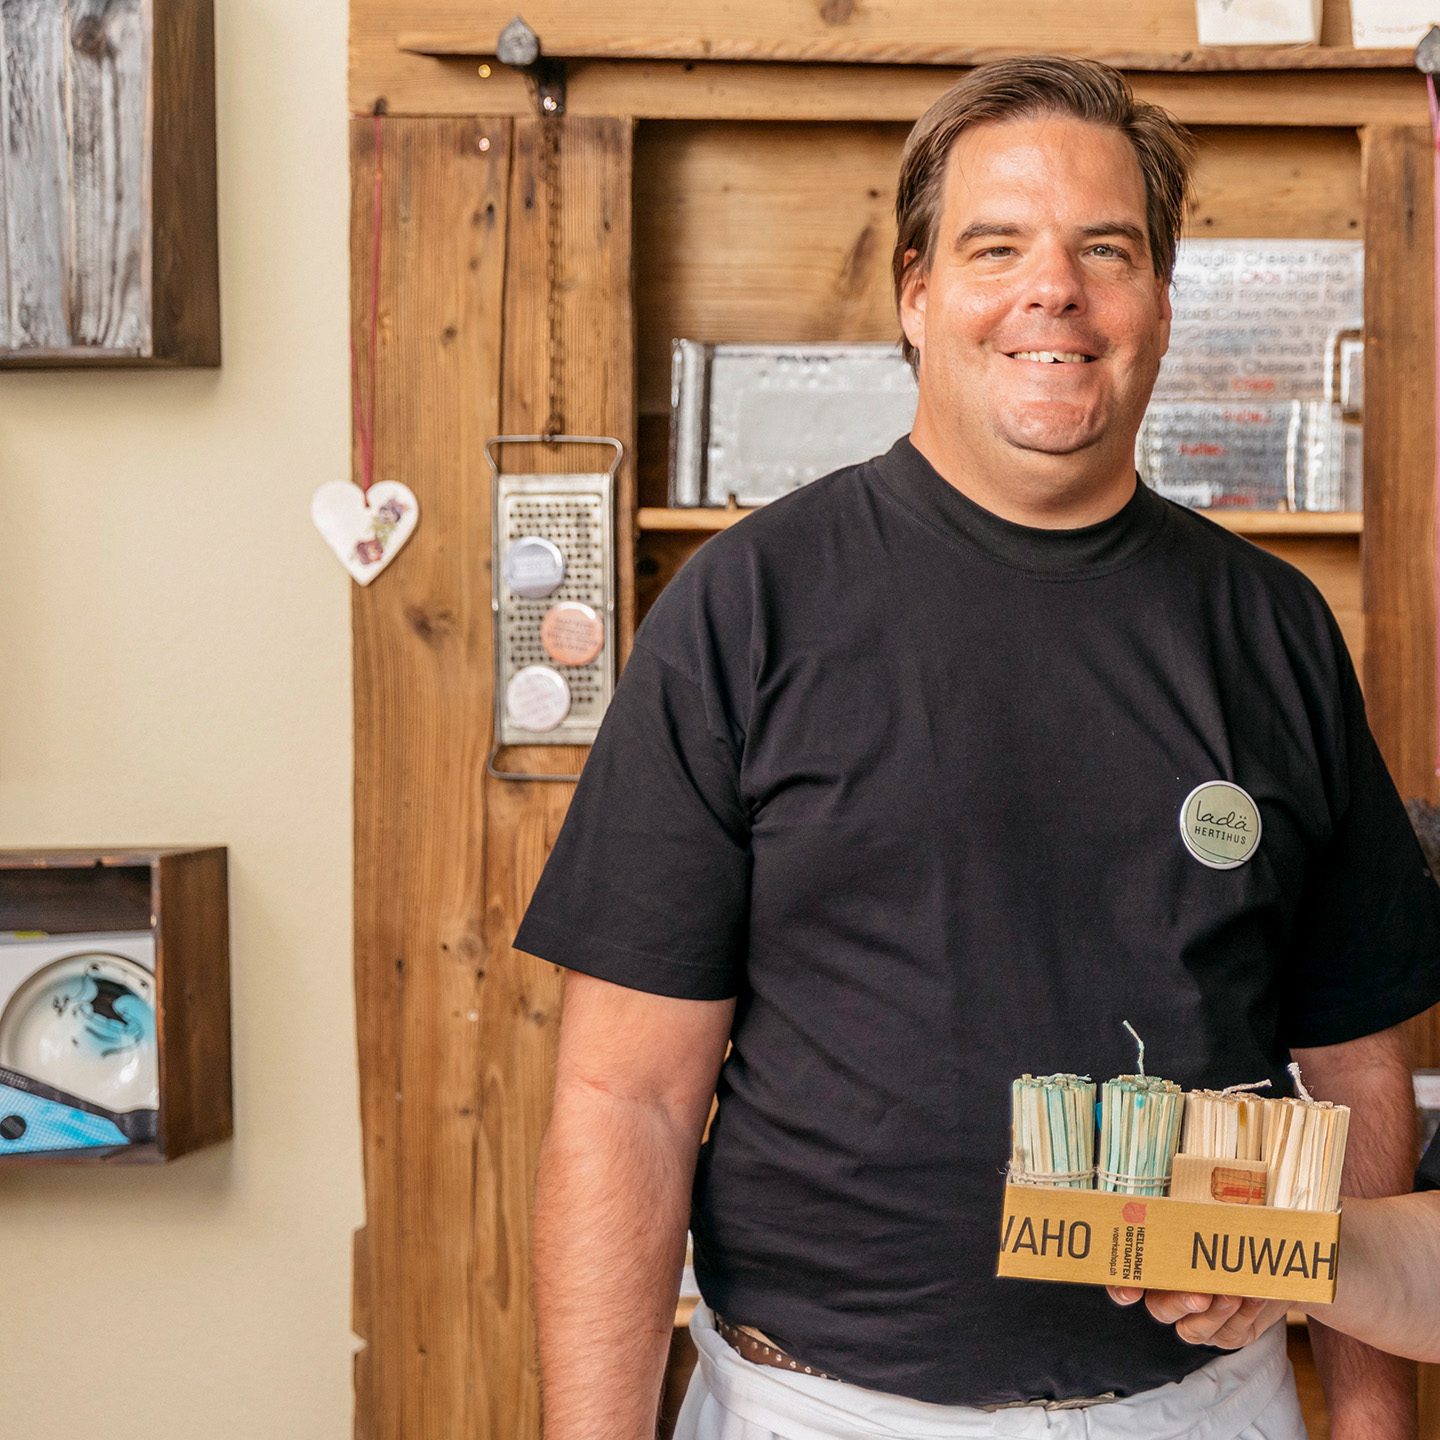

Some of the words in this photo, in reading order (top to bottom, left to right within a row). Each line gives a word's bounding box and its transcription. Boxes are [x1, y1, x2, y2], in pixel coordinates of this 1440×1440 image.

[1194, 825, 1247, 845] HERTIHUS
[1122, 1225, 1135, 1280] OBSTGARTEN
[1133, 1226, 1146, 1281] HEILSARMEE
[1191, 1231, 1337, 1280] NUWAH
